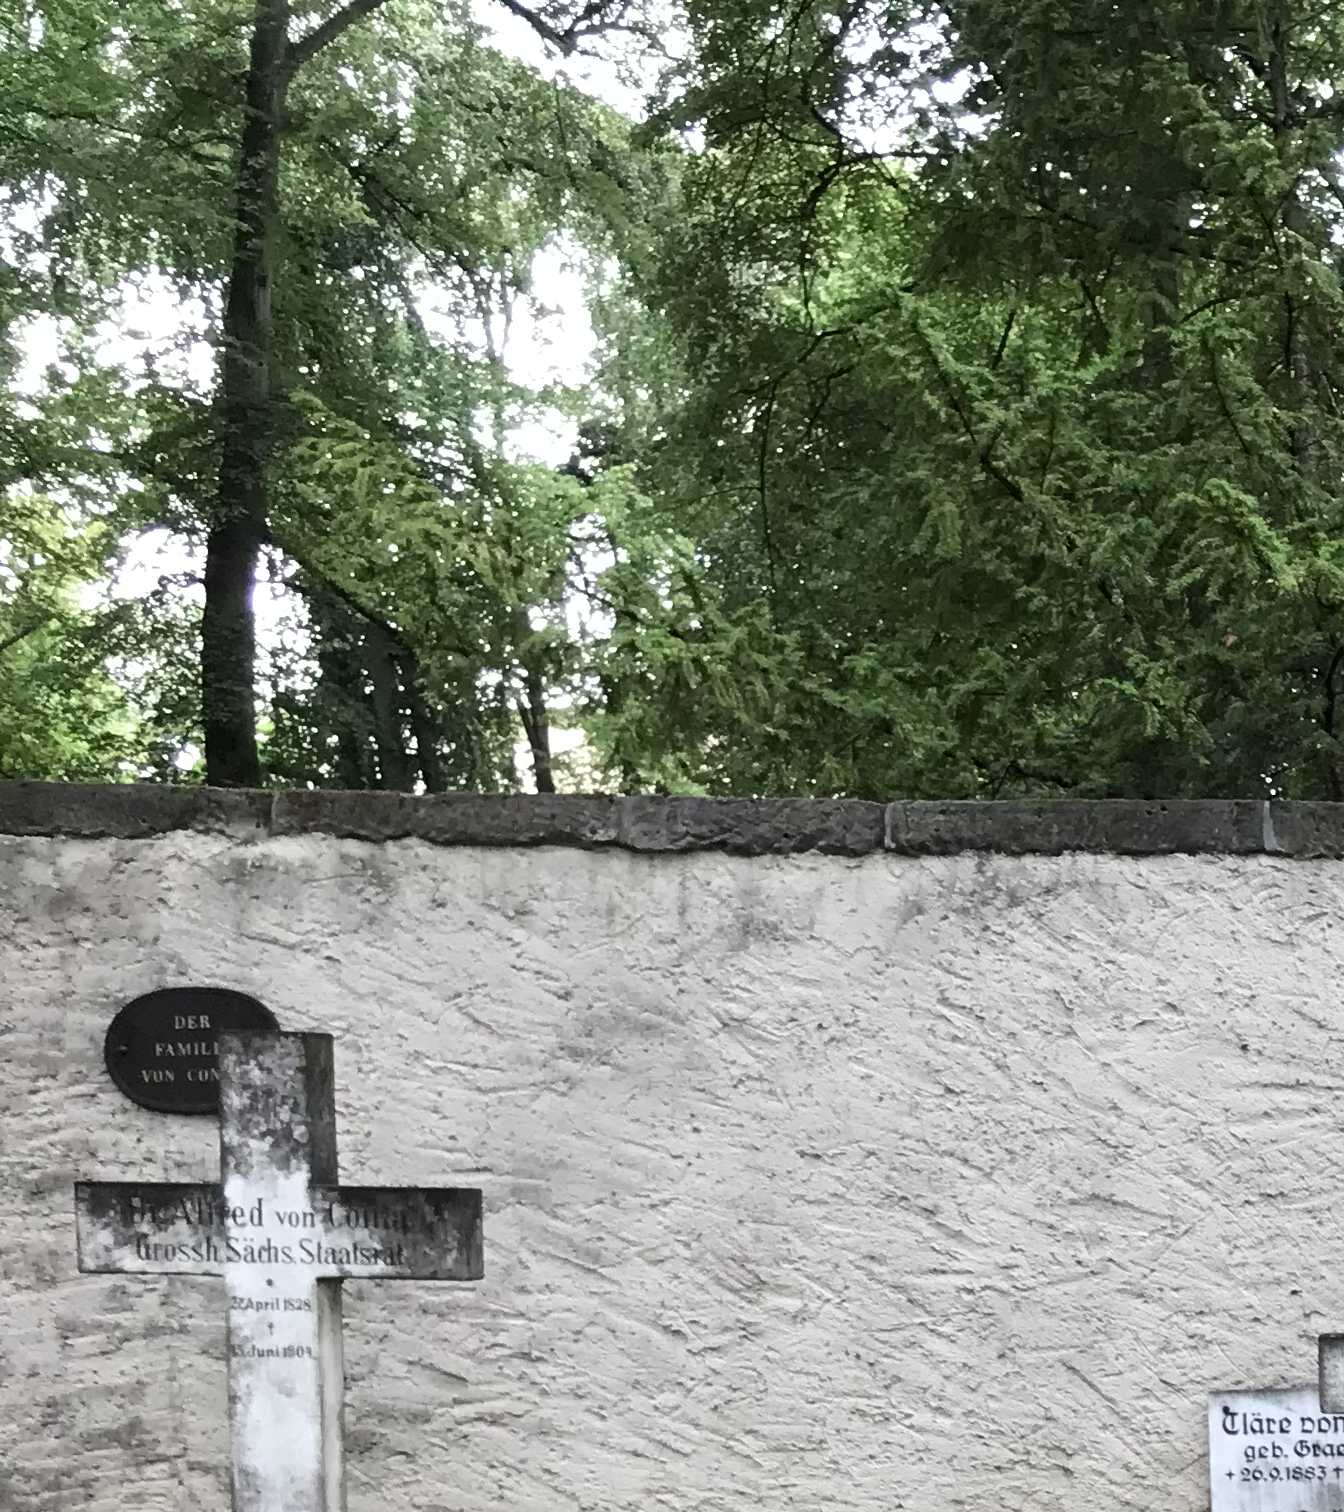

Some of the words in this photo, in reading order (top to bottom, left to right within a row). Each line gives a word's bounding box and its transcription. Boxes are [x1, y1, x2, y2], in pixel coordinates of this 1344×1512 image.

[174, 1014, 211, 1030] DER
[155, 1041, 220, 1057] FAMILI
[186, 1068, 220, 1082] CON
[275, 1208, 316, 1229] von
[299, 1238, 406, 1267] Staatsrat
[1221, 1410, 1293, 1436] Cläre
[1243, 1440, 1289, 1463] geb.
